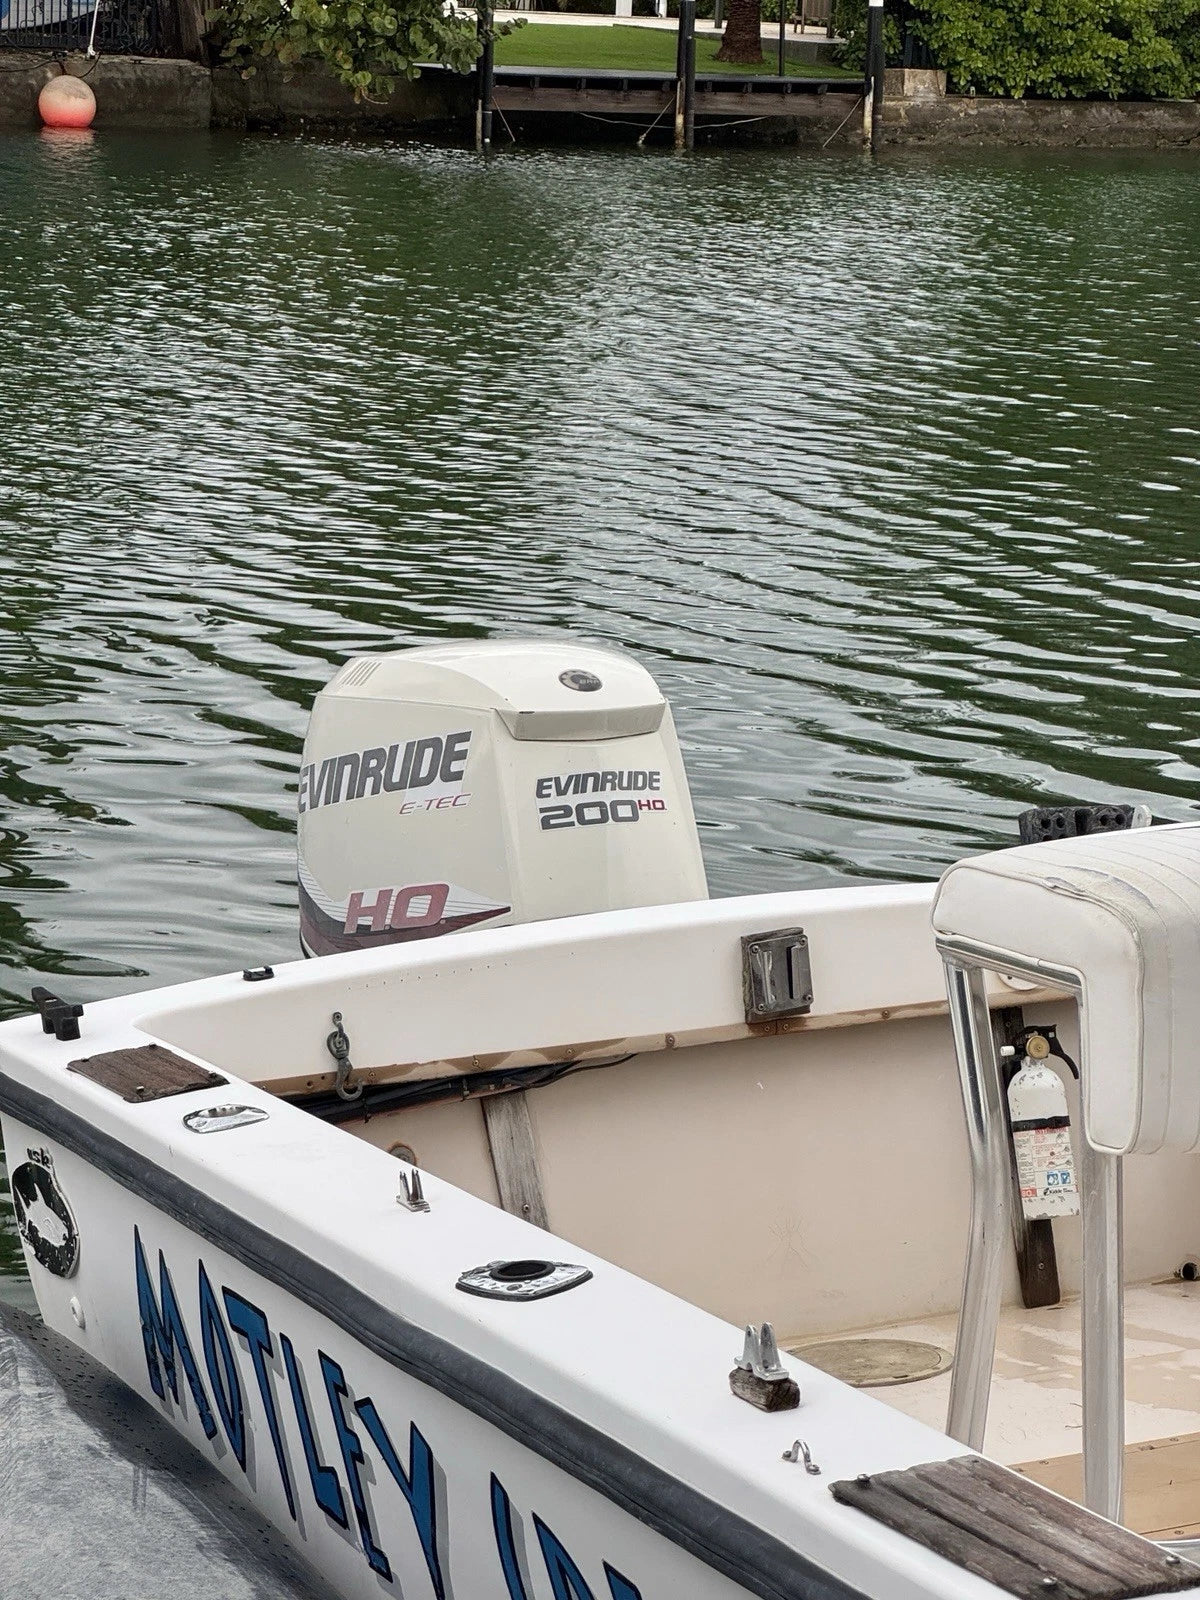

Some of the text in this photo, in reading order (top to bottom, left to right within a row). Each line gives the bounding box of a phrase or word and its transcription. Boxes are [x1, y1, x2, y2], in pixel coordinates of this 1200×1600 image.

[535, 770, 661, 799] EVINRUDE
[399, 793, 471, 815] E-TEC
[538, 799, 640, 830] 200
[133, 1224, 446, 1600] MOTLEY
